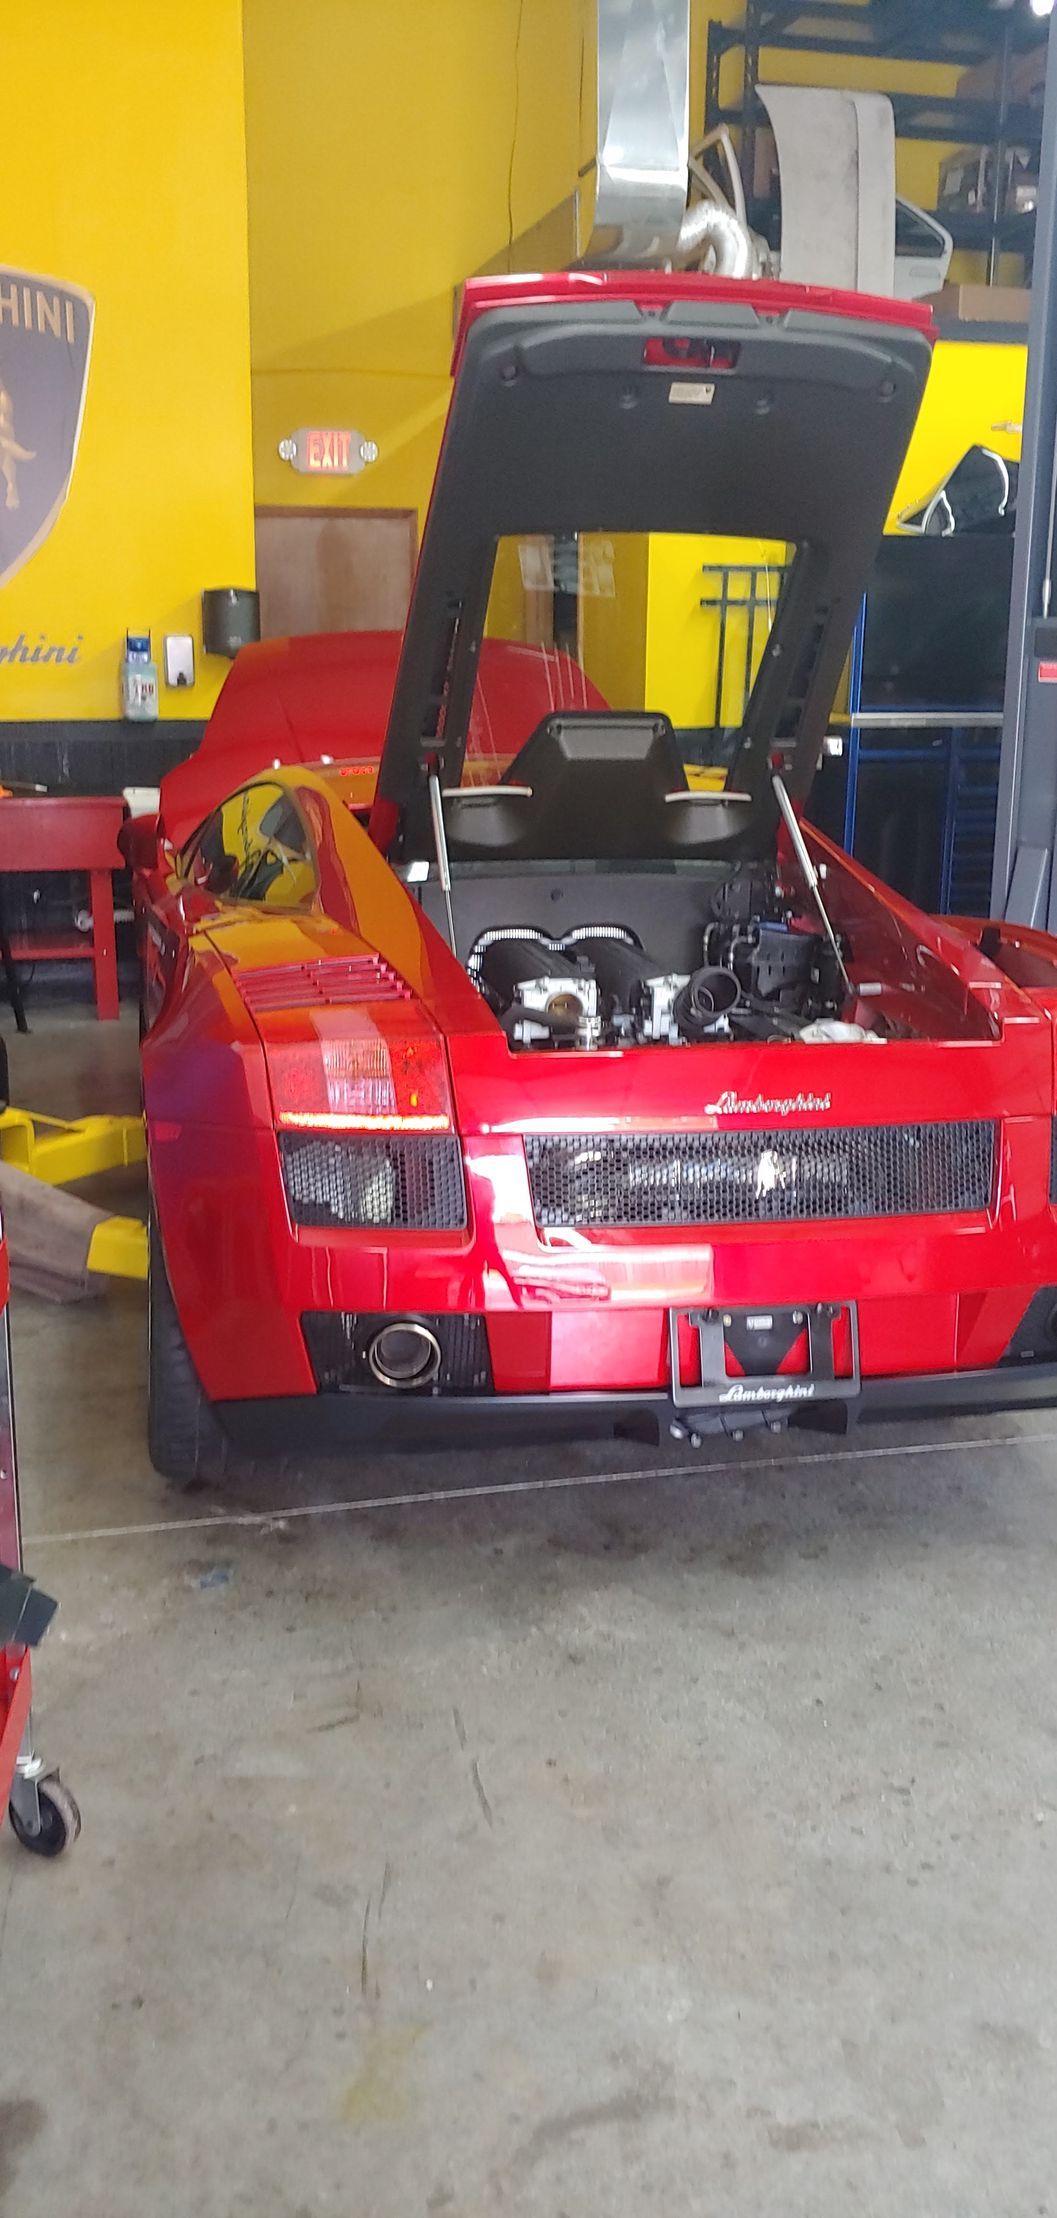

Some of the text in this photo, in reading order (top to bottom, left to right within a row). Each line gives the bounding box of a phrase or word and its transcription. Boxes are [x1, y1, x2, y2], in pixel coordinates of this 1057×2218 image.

[308, 431, 351, 470] EXIT
[704, 1090, 831, 1116] Lamborghini
[719, 1383, 815, 1403] Lamborghini
